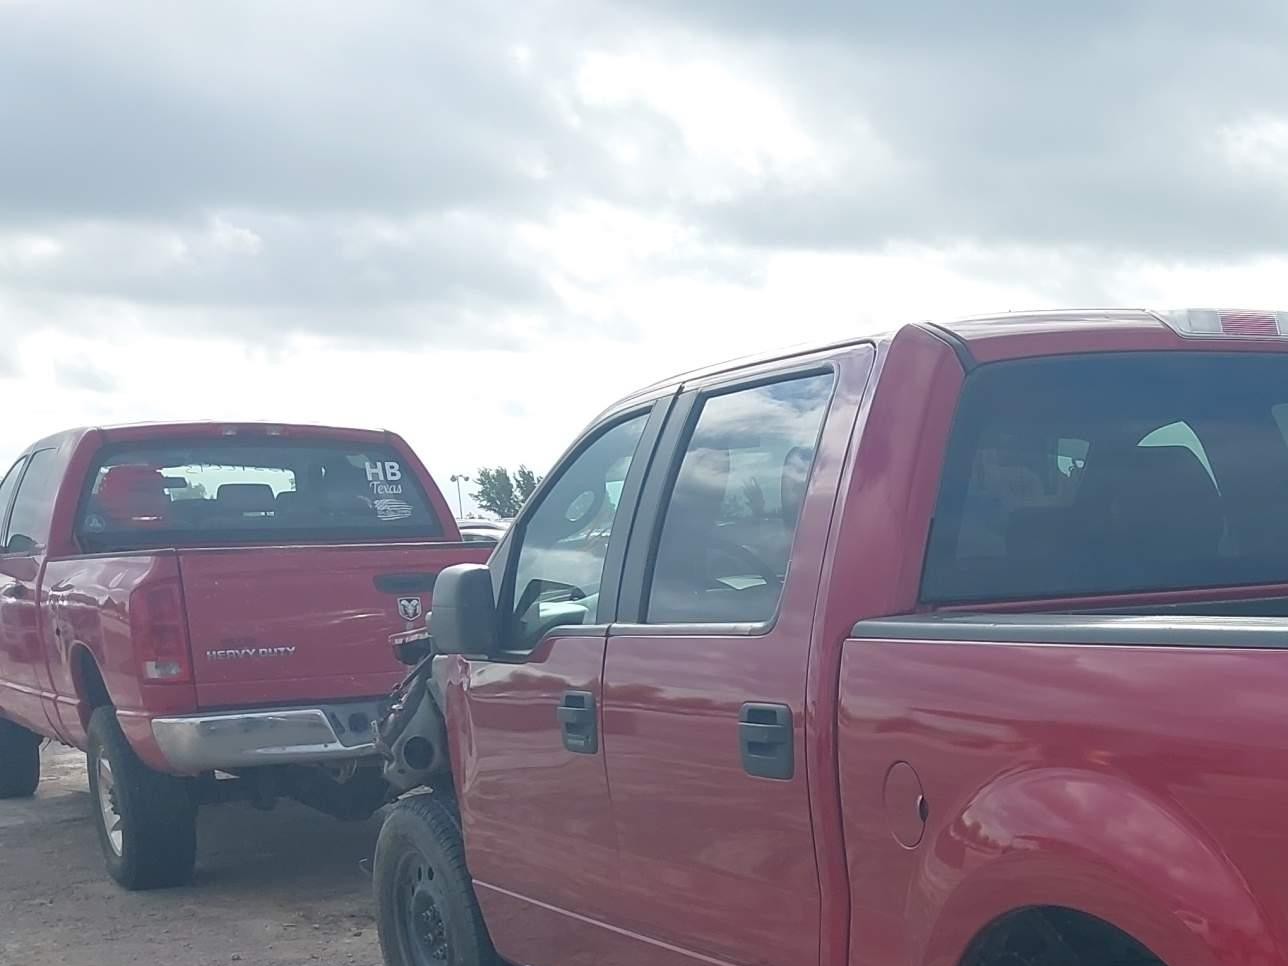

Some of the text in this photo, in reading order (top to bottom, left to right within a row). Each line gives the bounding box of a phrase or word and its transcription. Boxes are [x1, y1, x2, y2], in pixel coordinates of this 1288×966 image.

[364, 461, 402, 481] HB
[369, 481, 403, 495] Texas
[206, 646, 296, 661] HEAVY DUTY
